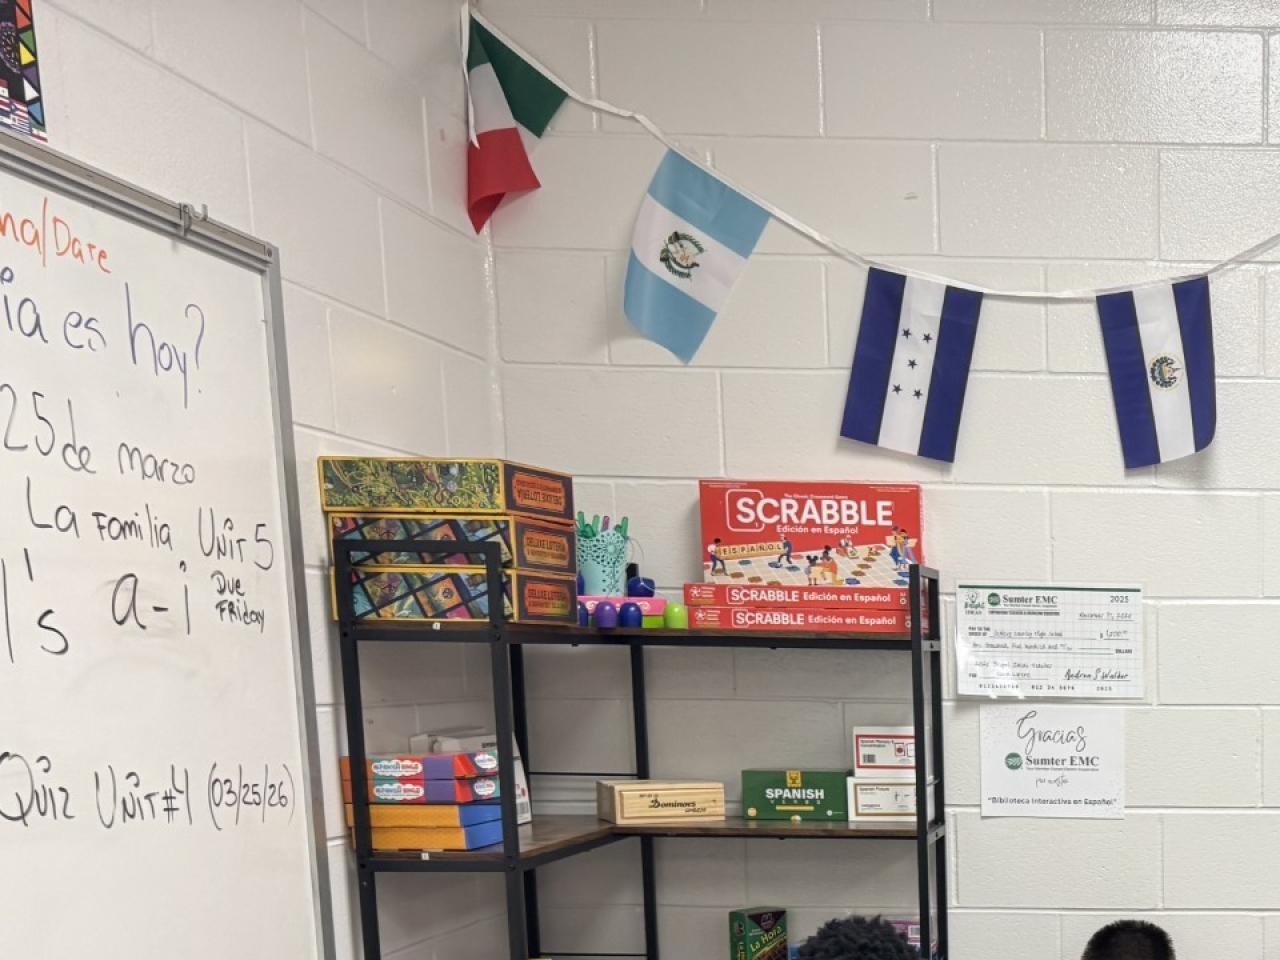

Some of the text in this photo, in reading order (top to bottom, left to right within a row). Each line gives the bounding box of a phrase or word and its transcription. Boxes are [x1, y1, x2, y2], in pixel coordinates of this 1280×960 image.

[63, 310, 107, 352] es
[124, 282, 206, 410] hoy?
[61, 398, 97, 475] de
[118, 442, 196, 486] marzo
[735, 497, 893, 526] SCRABBLE
[26, 476, 80, 540] La
[253, 523, 274, 570] 5
[776, 524, 809, 534] Edición
[824, 525, 859, 535] Español
[730, 588, 799, 602] SCRABBLE
[803, 591, 837, 601] Edición
[854, 592, 891, 603] Español
[1003, 595, 1058, 604] Sumter EMC
[1110, 595, 1129, 603] 2025
[735, 612, 804, 626] SCRABBLE
[808, 615, 842, 625] Edición
[859, 615, 896, 627] Español
[1016, 710, 1087, 755] Gracias
[1025, 756, 1100, 766] Sumter EMC
[207, 762, 297, 831] (03/25/26)
[765, 788, 824, 799] SPANISH
